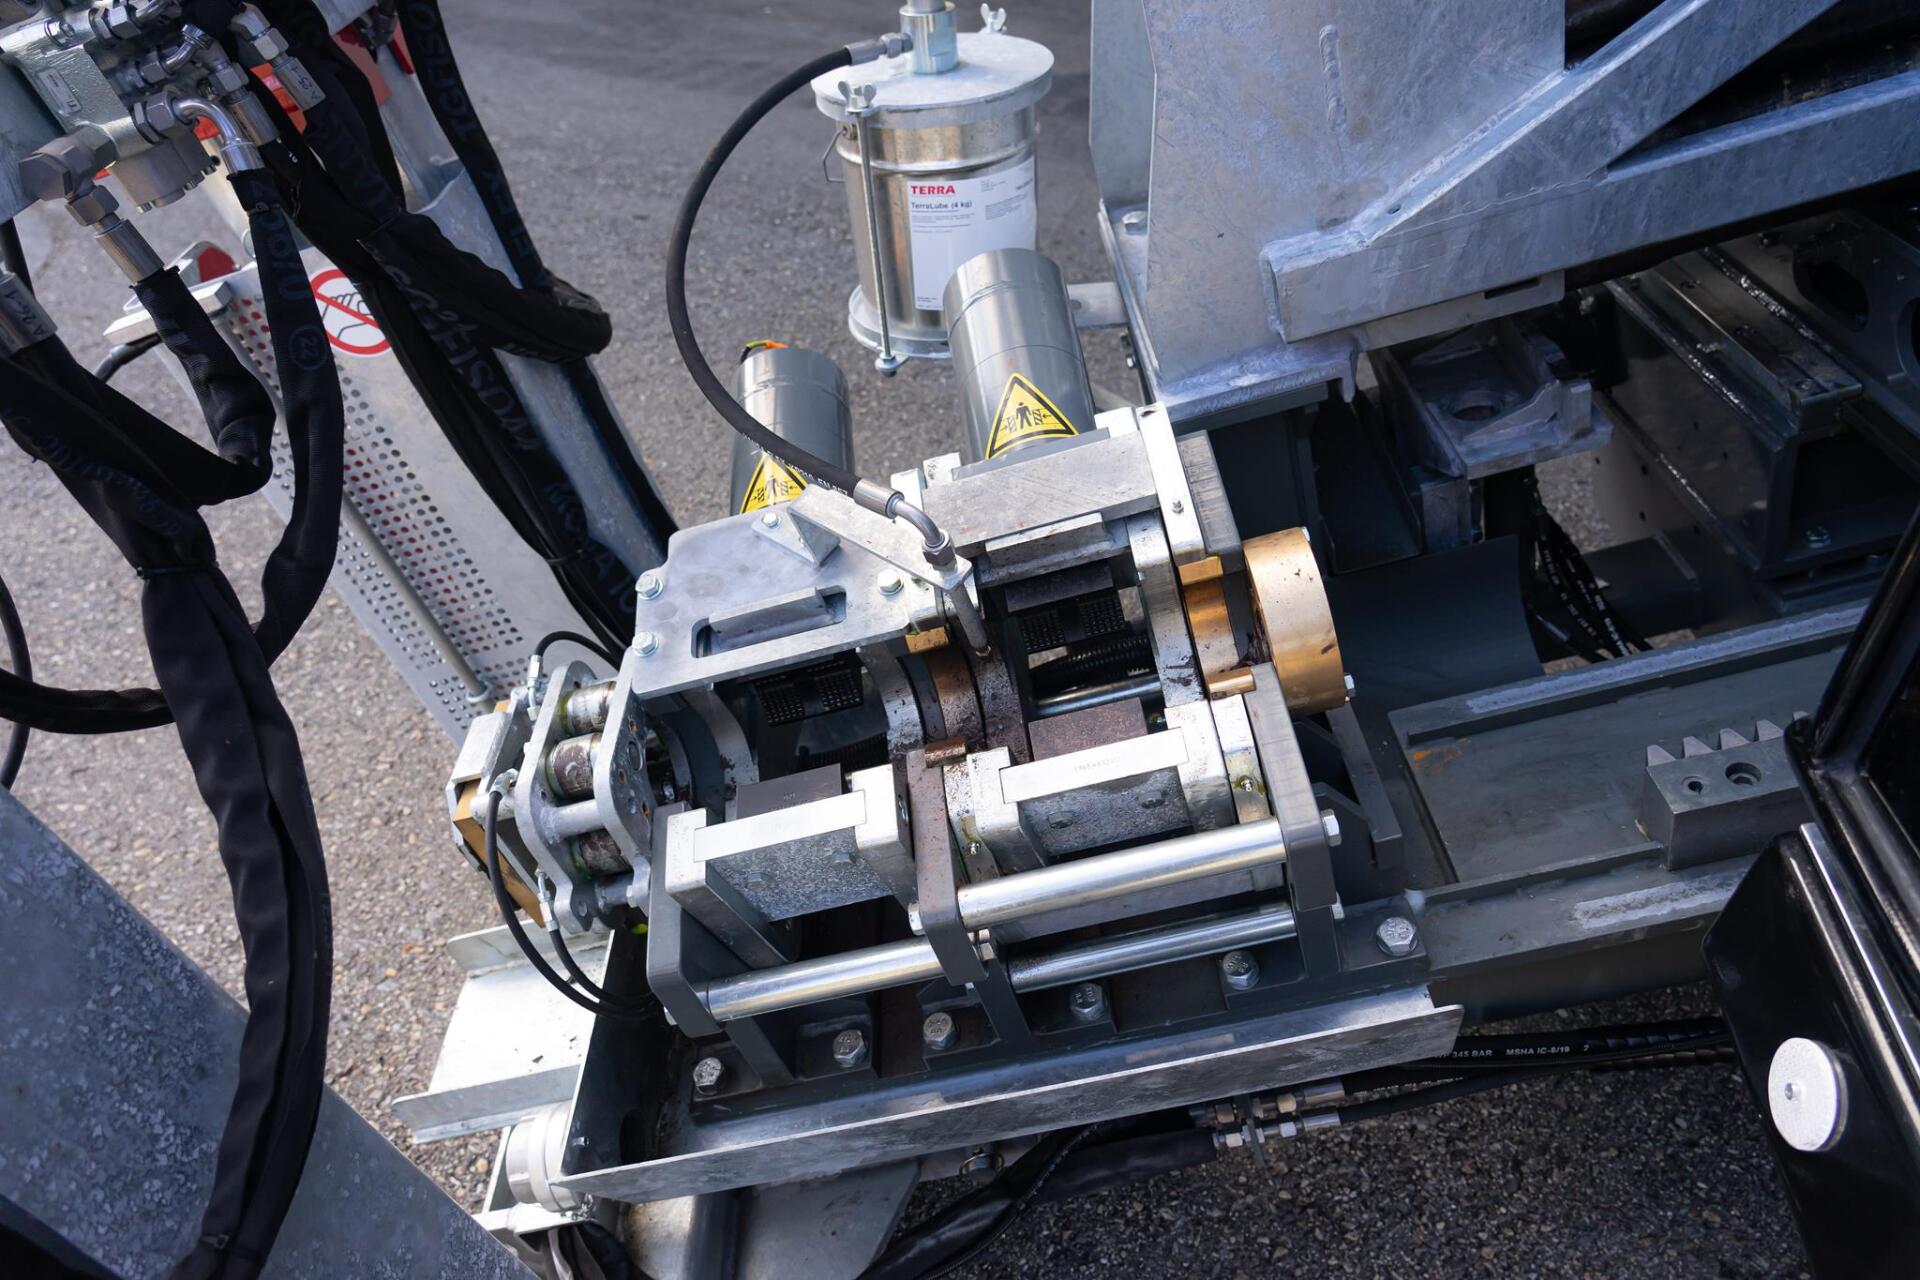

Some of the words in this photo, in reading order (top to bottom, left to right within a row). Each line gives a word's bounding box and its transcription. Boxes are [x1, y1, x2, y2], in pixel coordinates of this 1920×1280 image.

[911, 185, 956, 195] TERRA
[1471, 1049, 1493, 1057] BAR
[1505, 1047, 1535, 1056] MSHA
